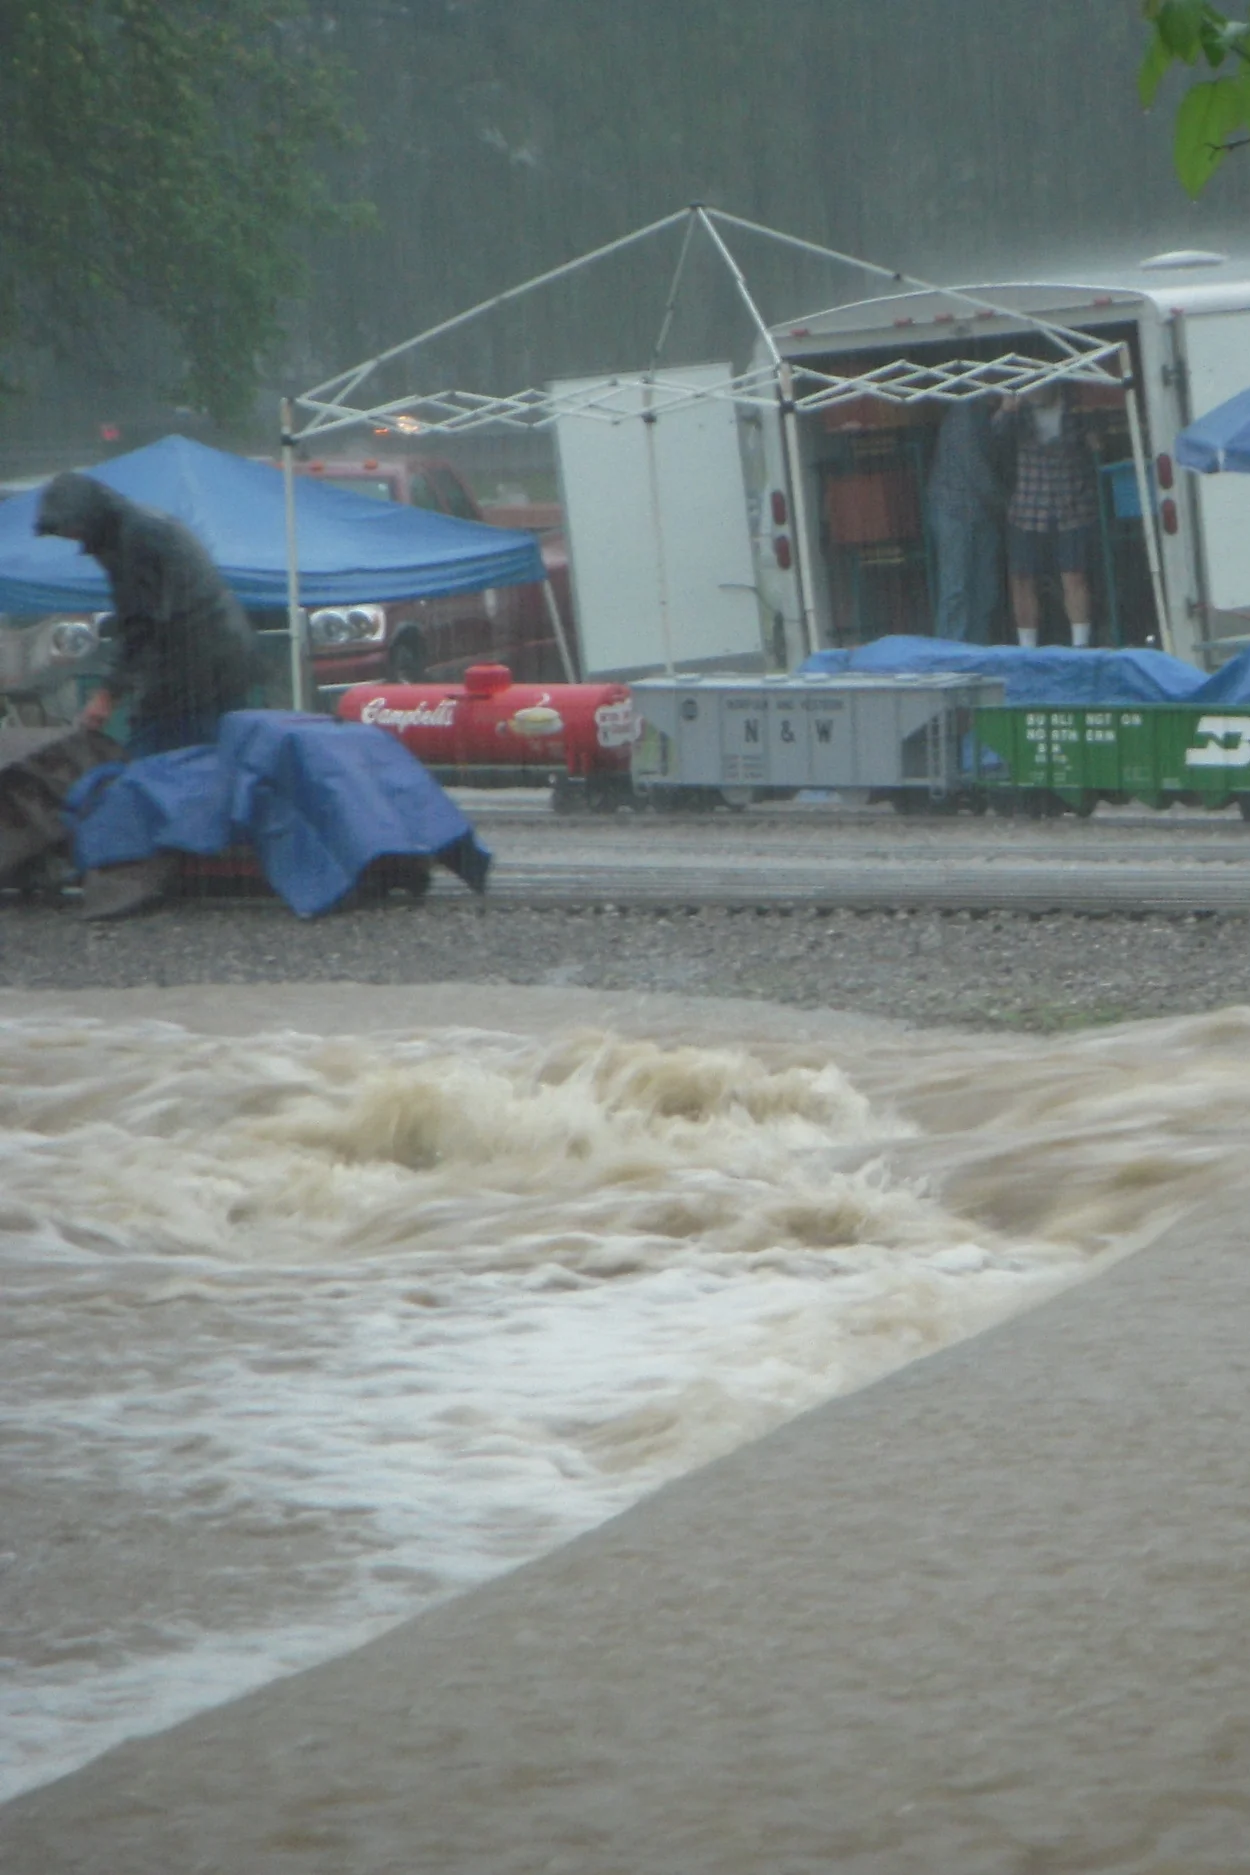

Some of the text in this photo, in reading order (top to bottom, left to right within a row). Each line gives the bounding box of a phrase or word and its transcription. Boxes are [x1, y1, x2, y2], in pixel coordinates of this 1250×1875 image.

[744, 719, 833, 743] N & W
